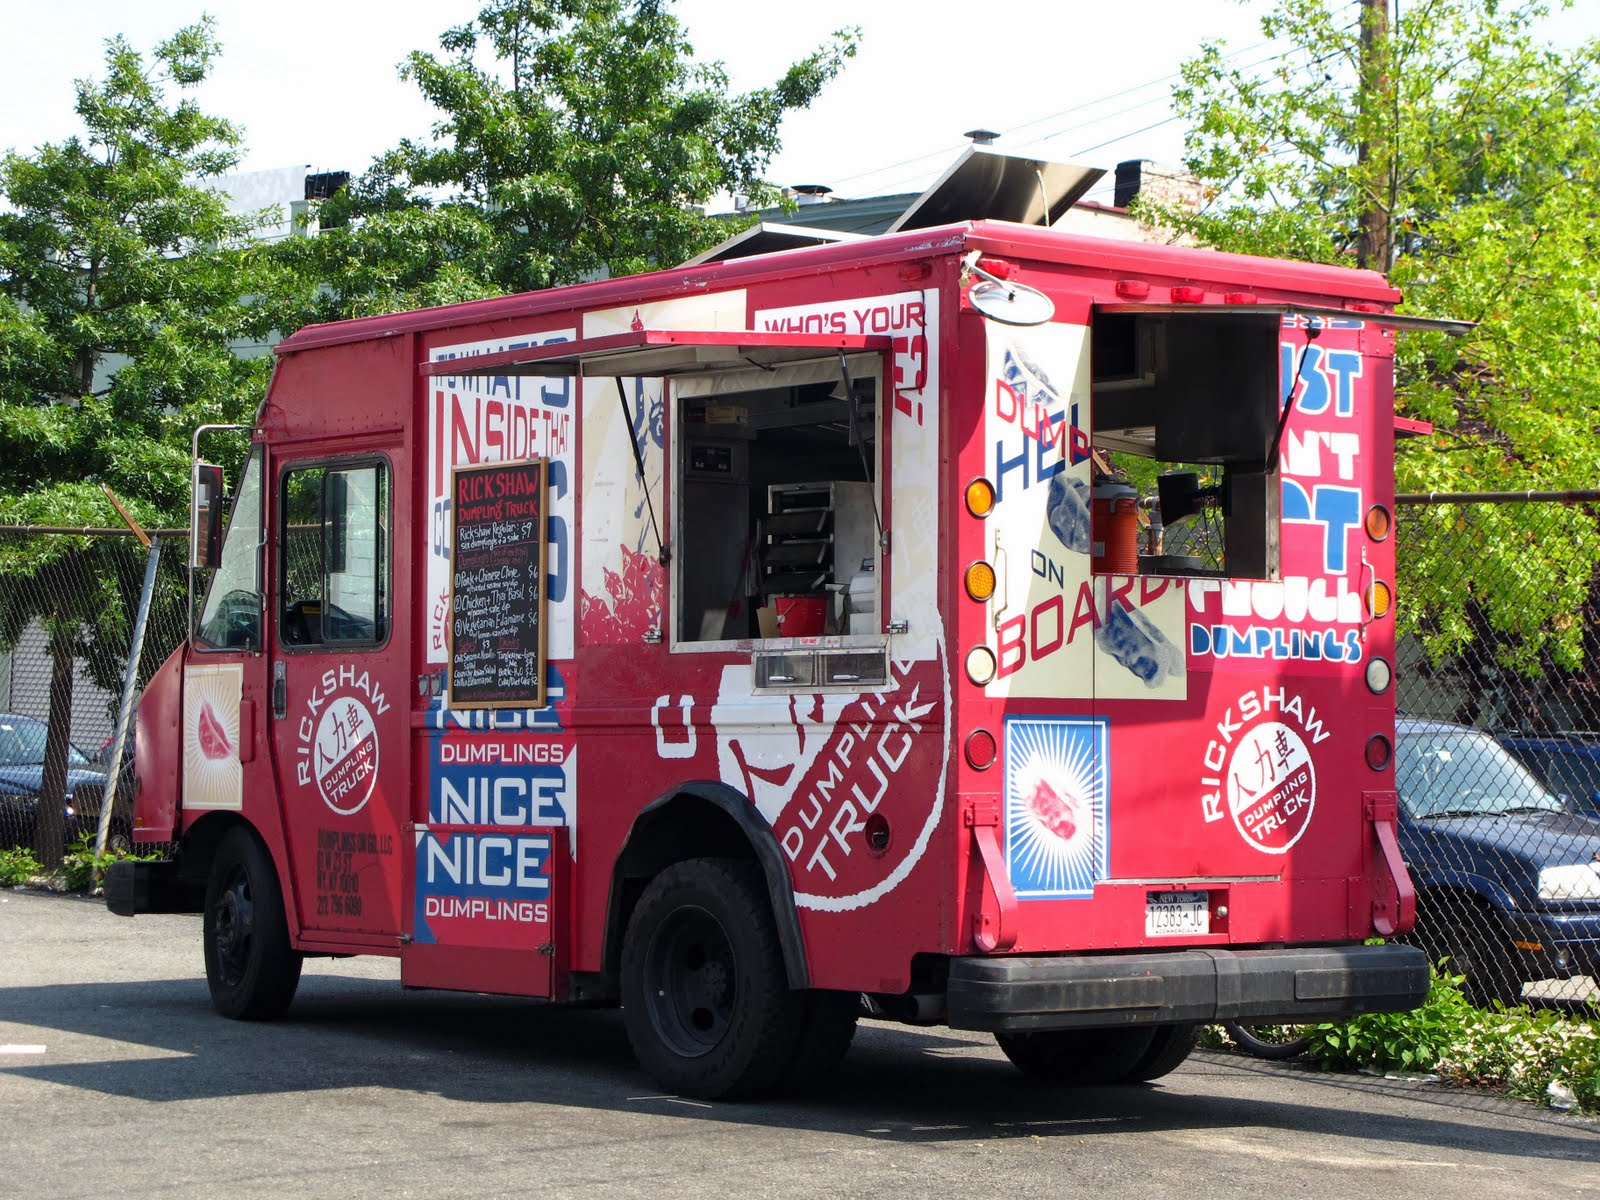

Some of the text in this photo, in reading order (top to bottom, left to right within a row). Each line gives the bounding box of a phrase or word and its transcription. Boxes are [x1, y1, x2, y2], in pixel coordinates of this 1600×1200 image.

[853, 301, 927, 334] YOUR
[435, 391, 570, 497] INSIDE THAT
[506, 501, 538, 518] TRUCK
[521, 522, 533, 540] $9
[528, 562, 539, 579] $6
[1031, 549, 1064, 589] ON
[528, 583, 539, 602] $6
[528, 608, 538, 628] $6
[1190, 622, 1362, 664] DUMPLINGS
[297, 664, 391, 786] RICKSHAW
[324, 740, 374, 790] DUMPLING
[441, 744, 564, 763] DUMPLINGS
[1201, 686, 1331, 823] RICKSHAW
[330, 757, 375, 803] TRUCK
[806, 681, 938, 882] TRUCK
[441, 777, 567, 826] NICE
[427, 836, 549, 888] NICE
[425, 898, 548, 923] DUMPLINGS
